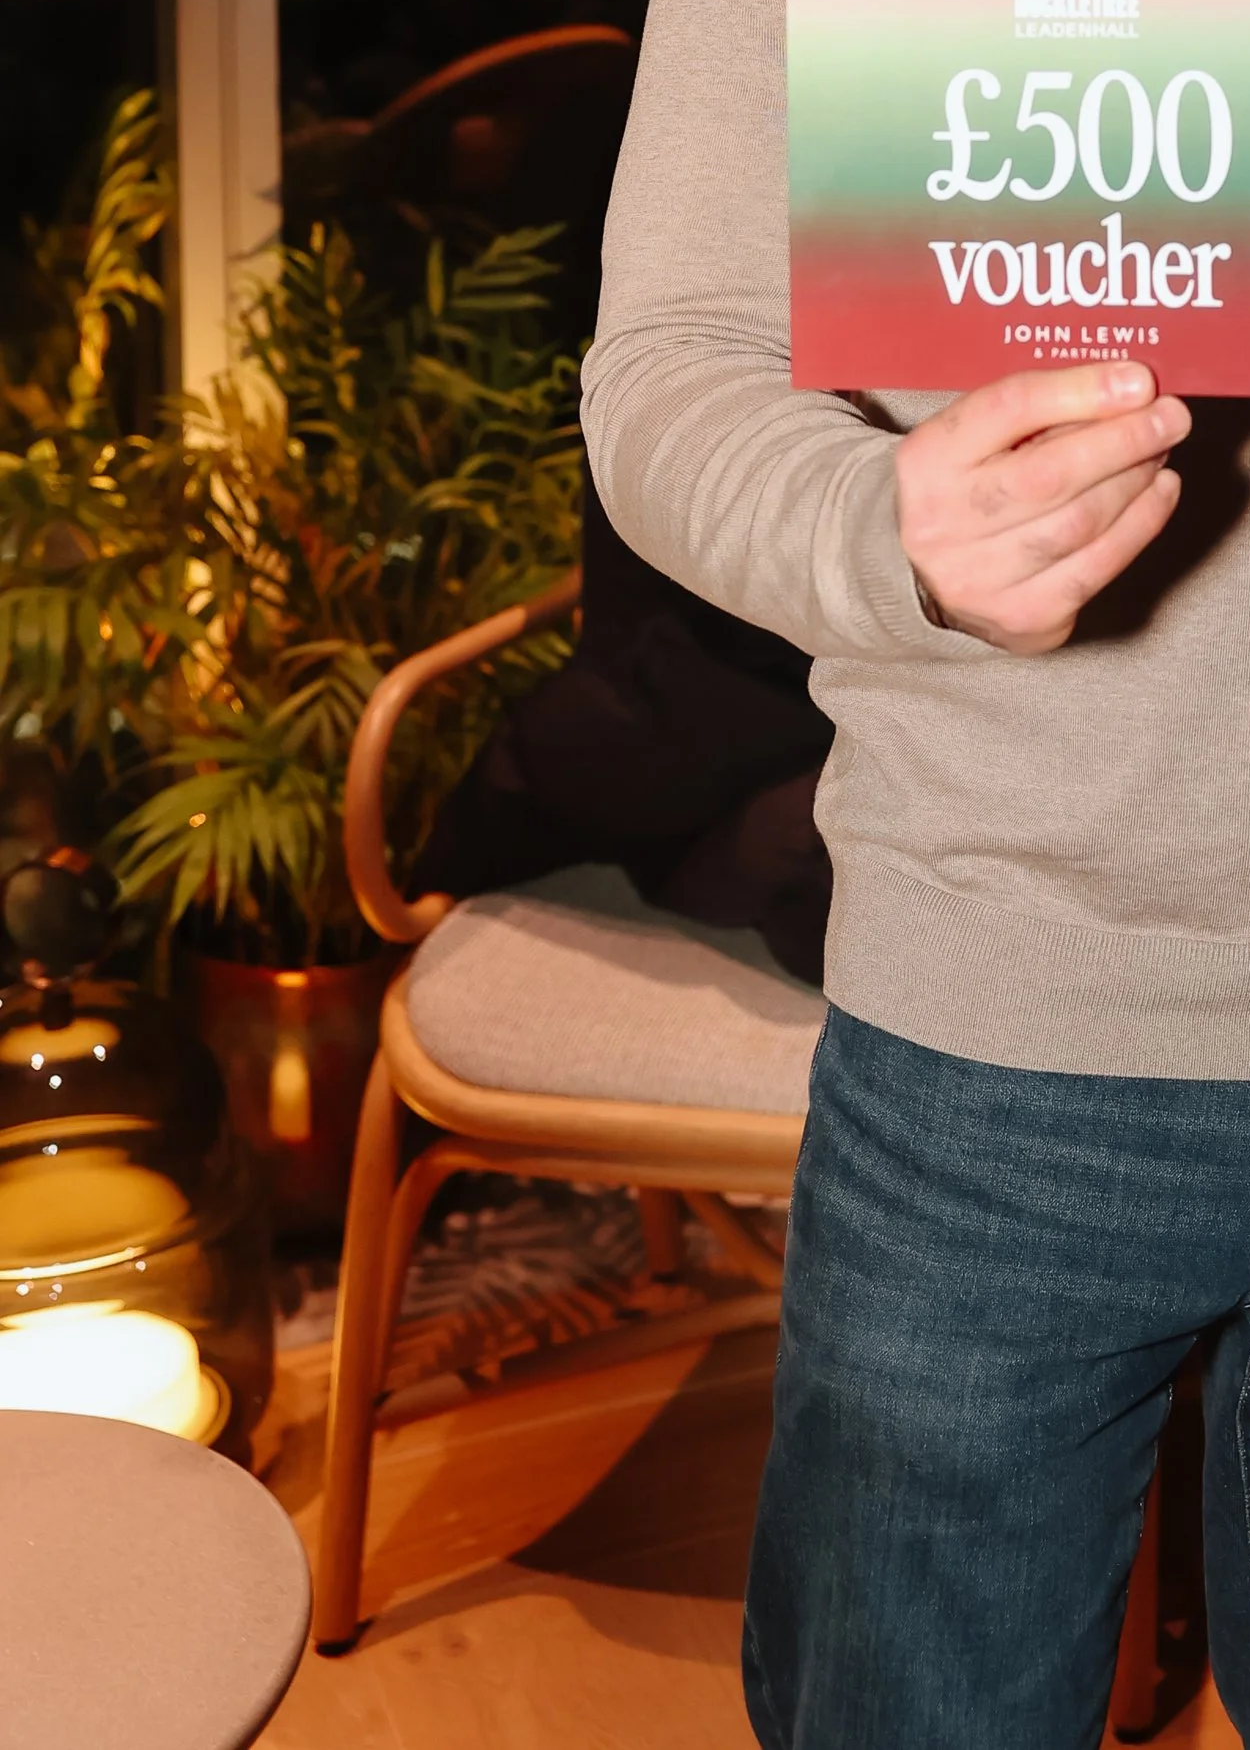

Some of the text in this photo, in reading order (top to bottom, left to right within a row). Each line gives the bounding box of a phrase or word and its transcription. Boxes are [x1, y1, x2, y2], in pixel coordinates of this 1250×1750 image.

[1014, 21, 1140, 38] LEADENHALL
[925, 69, 1233, 202] £500
[928, 212, 1231, 309] voucher
[1004, 324, 1160, 345] JOHN LEWIS
[1033, 347, 1129, 360] & PARTNERS
